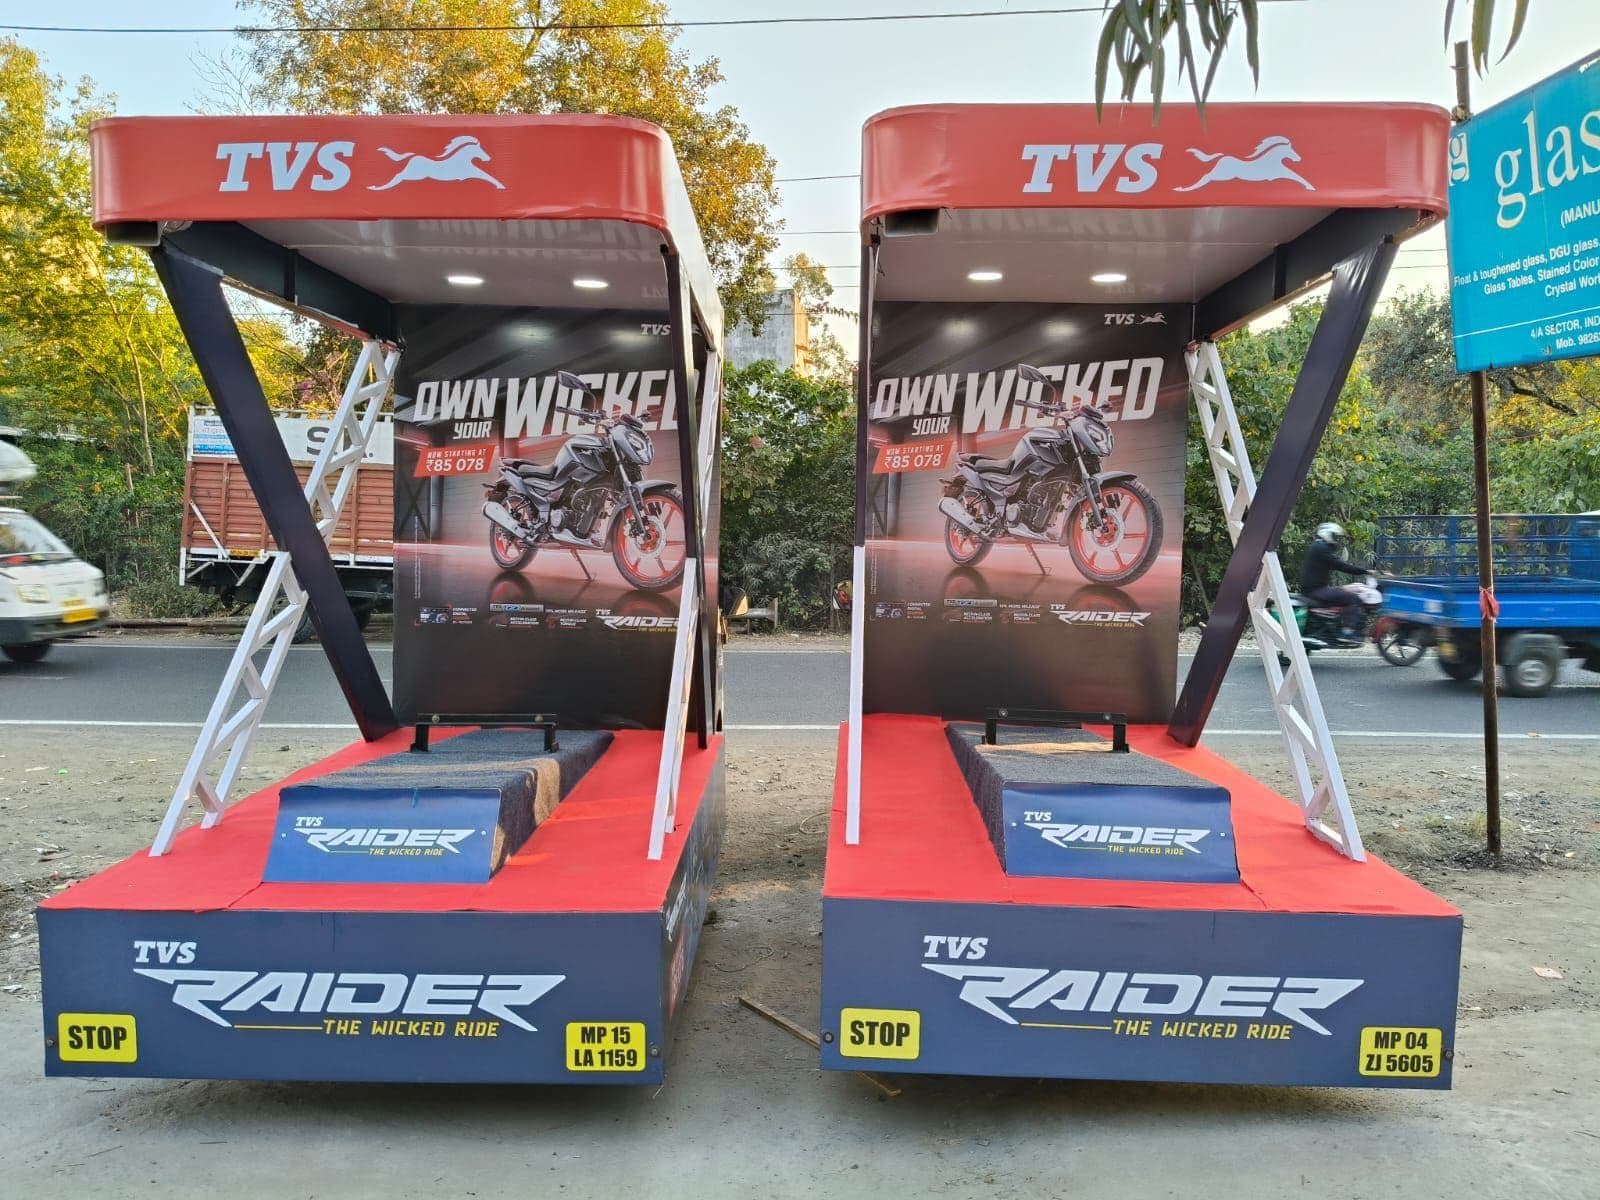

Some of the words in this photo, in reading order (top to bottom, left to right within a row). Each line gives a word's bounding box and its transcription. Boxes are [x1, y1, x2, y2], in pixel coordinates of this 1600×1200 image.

[216, 141, 355, 192] TVS
[1021, 143, 1163, 192] TVS
[1454, 272, 1471, 287] Float
[1473, 270, 1479, 281] &
[1480, 259, 1520, 280] toughened
[1523, 254, 1548, 270] glass,
[1549, 243, 1570, 260] DGU
[1484, 282, 1506, 294] Glass
[1507, 275, 1535, 288] Tables,
[1537, 262, 1571, 281] Stained
[1573, 256, 1599, 272] Color
[1545, 278, 1577, 297] Crystal
[1104, 313, 1135, 325] TVS
[1545, 319, 1583, 336] SECTOR,
[641, 324, 671, 336] TVS
[1556, 337, 1577, 349] Mob.
[413, 378, 499, 422] OWN
[873, 373, 958, 419] OWN
[962, 357, 1164, 434] WICKED
[453, 421, 491, 440] YOUR
[912, 416, 951, 436] YOUR
[427, 451, 442, 459] NOW
[444, 448, 477, 458] STARTING
[478, 448, 487, 456] AT
[886, 447, 900, 455] NOW
[902, 445, 934, 455] STARTING
[936, 444, 944, 452] AT
[426, 458, 453, 472] ₹85
[884, 455, 909, 468] ₹85
[1050, 611, 1152, 627] RAIDER
[296, 816, 324, 827] TVS
[1024, 811, 1052, 822] TVS
[294, 828, 476, 854] RAIDER
[1024, 822, 1212, 854] RAIDER
[368, 848, 385, 856] THE
[388, 848, 422, 857] WICKED
[424, 848, 444, 857] RIDE
[1107, 845, 1125, 853] THE
[1128, 846, 1161, 855] WICKED
[1164, 847, 1185, 856] RIDE
[133, 941, 197, 964] TVS
[923, 935, 988, 960] TVS
[133, 968, 566, 1032] RAIDER
[921, 963, 1365, 1036] RAIDER
[68, 1025, 127, 1050] STOP
[323, 1019, 362, 1036] THE
[371, 1020, 446, 1037] WICKED
[454, 1021, 500, 1038] RIDE
[581, 1026, 607, 1044] MP
[611, 1026, 631, 1044] 15
[850, 1020, 910, 1047] STOP
[1113, 1019, 1152, 1036] THE
[1161, 1021, 1239, 1039] WICKED
[1246, 1022, 1294, 1040] RIDE
[1374, 1031, 1401, 1049] MP
[1405, 1031, 1428, 1049] 04
[574, 1049, 594, 1067] LA
[597, 1049, 637, 1067] 1159
[1365, 1054, 1382, 1071] ZJ
[1386, 1054, 1434, 1072] 5605
